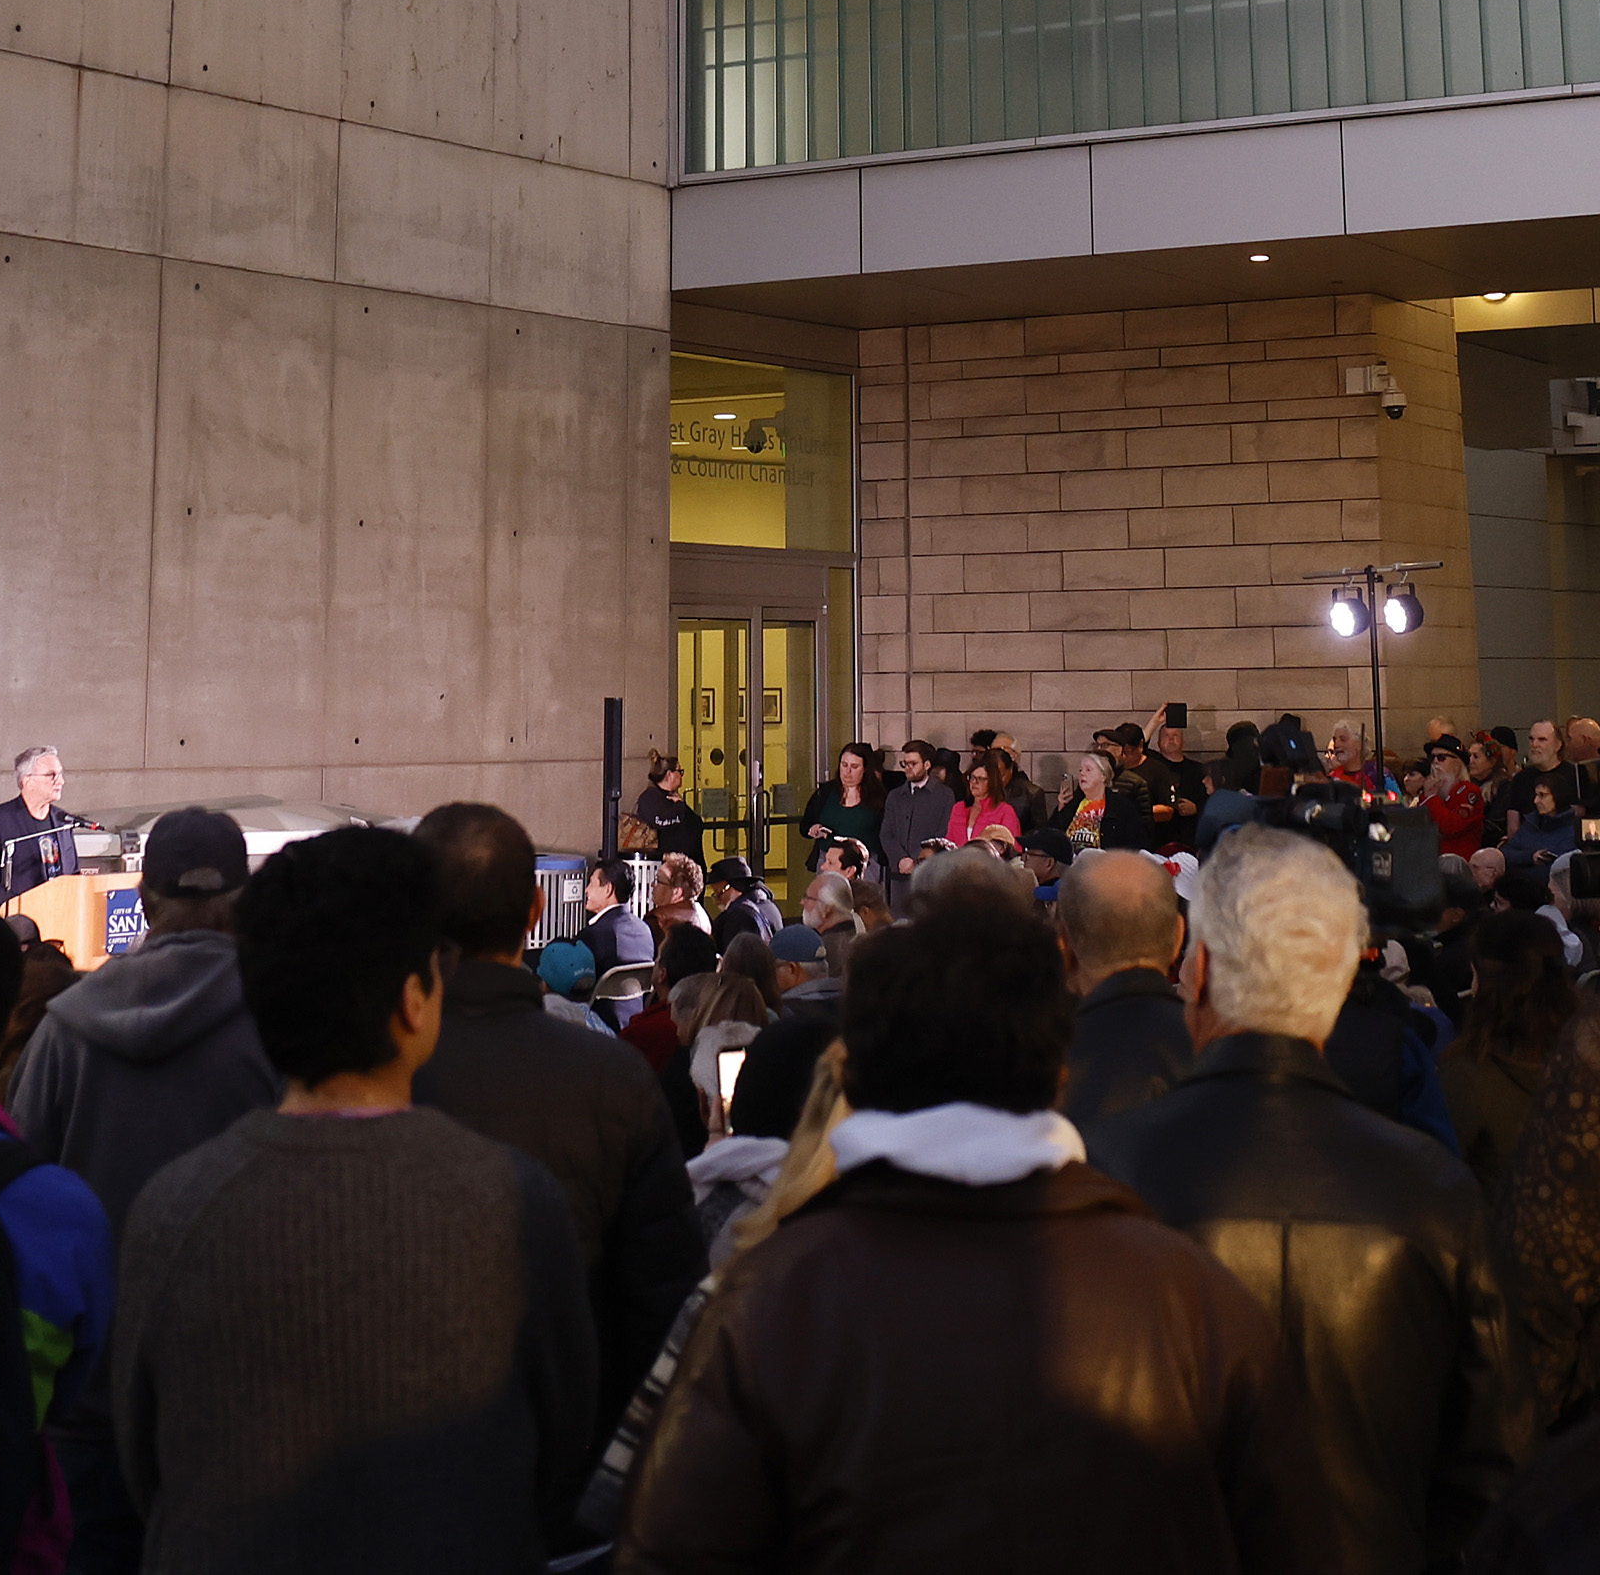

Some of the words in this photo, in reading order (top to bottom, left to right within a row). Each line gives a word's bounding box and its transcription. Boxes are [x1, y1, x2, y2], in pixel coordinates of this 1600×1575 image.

[690, 421, 725, 450] Gray
[687, 455, 744, 481] Council
[108, 915, 138, 933] SAN
